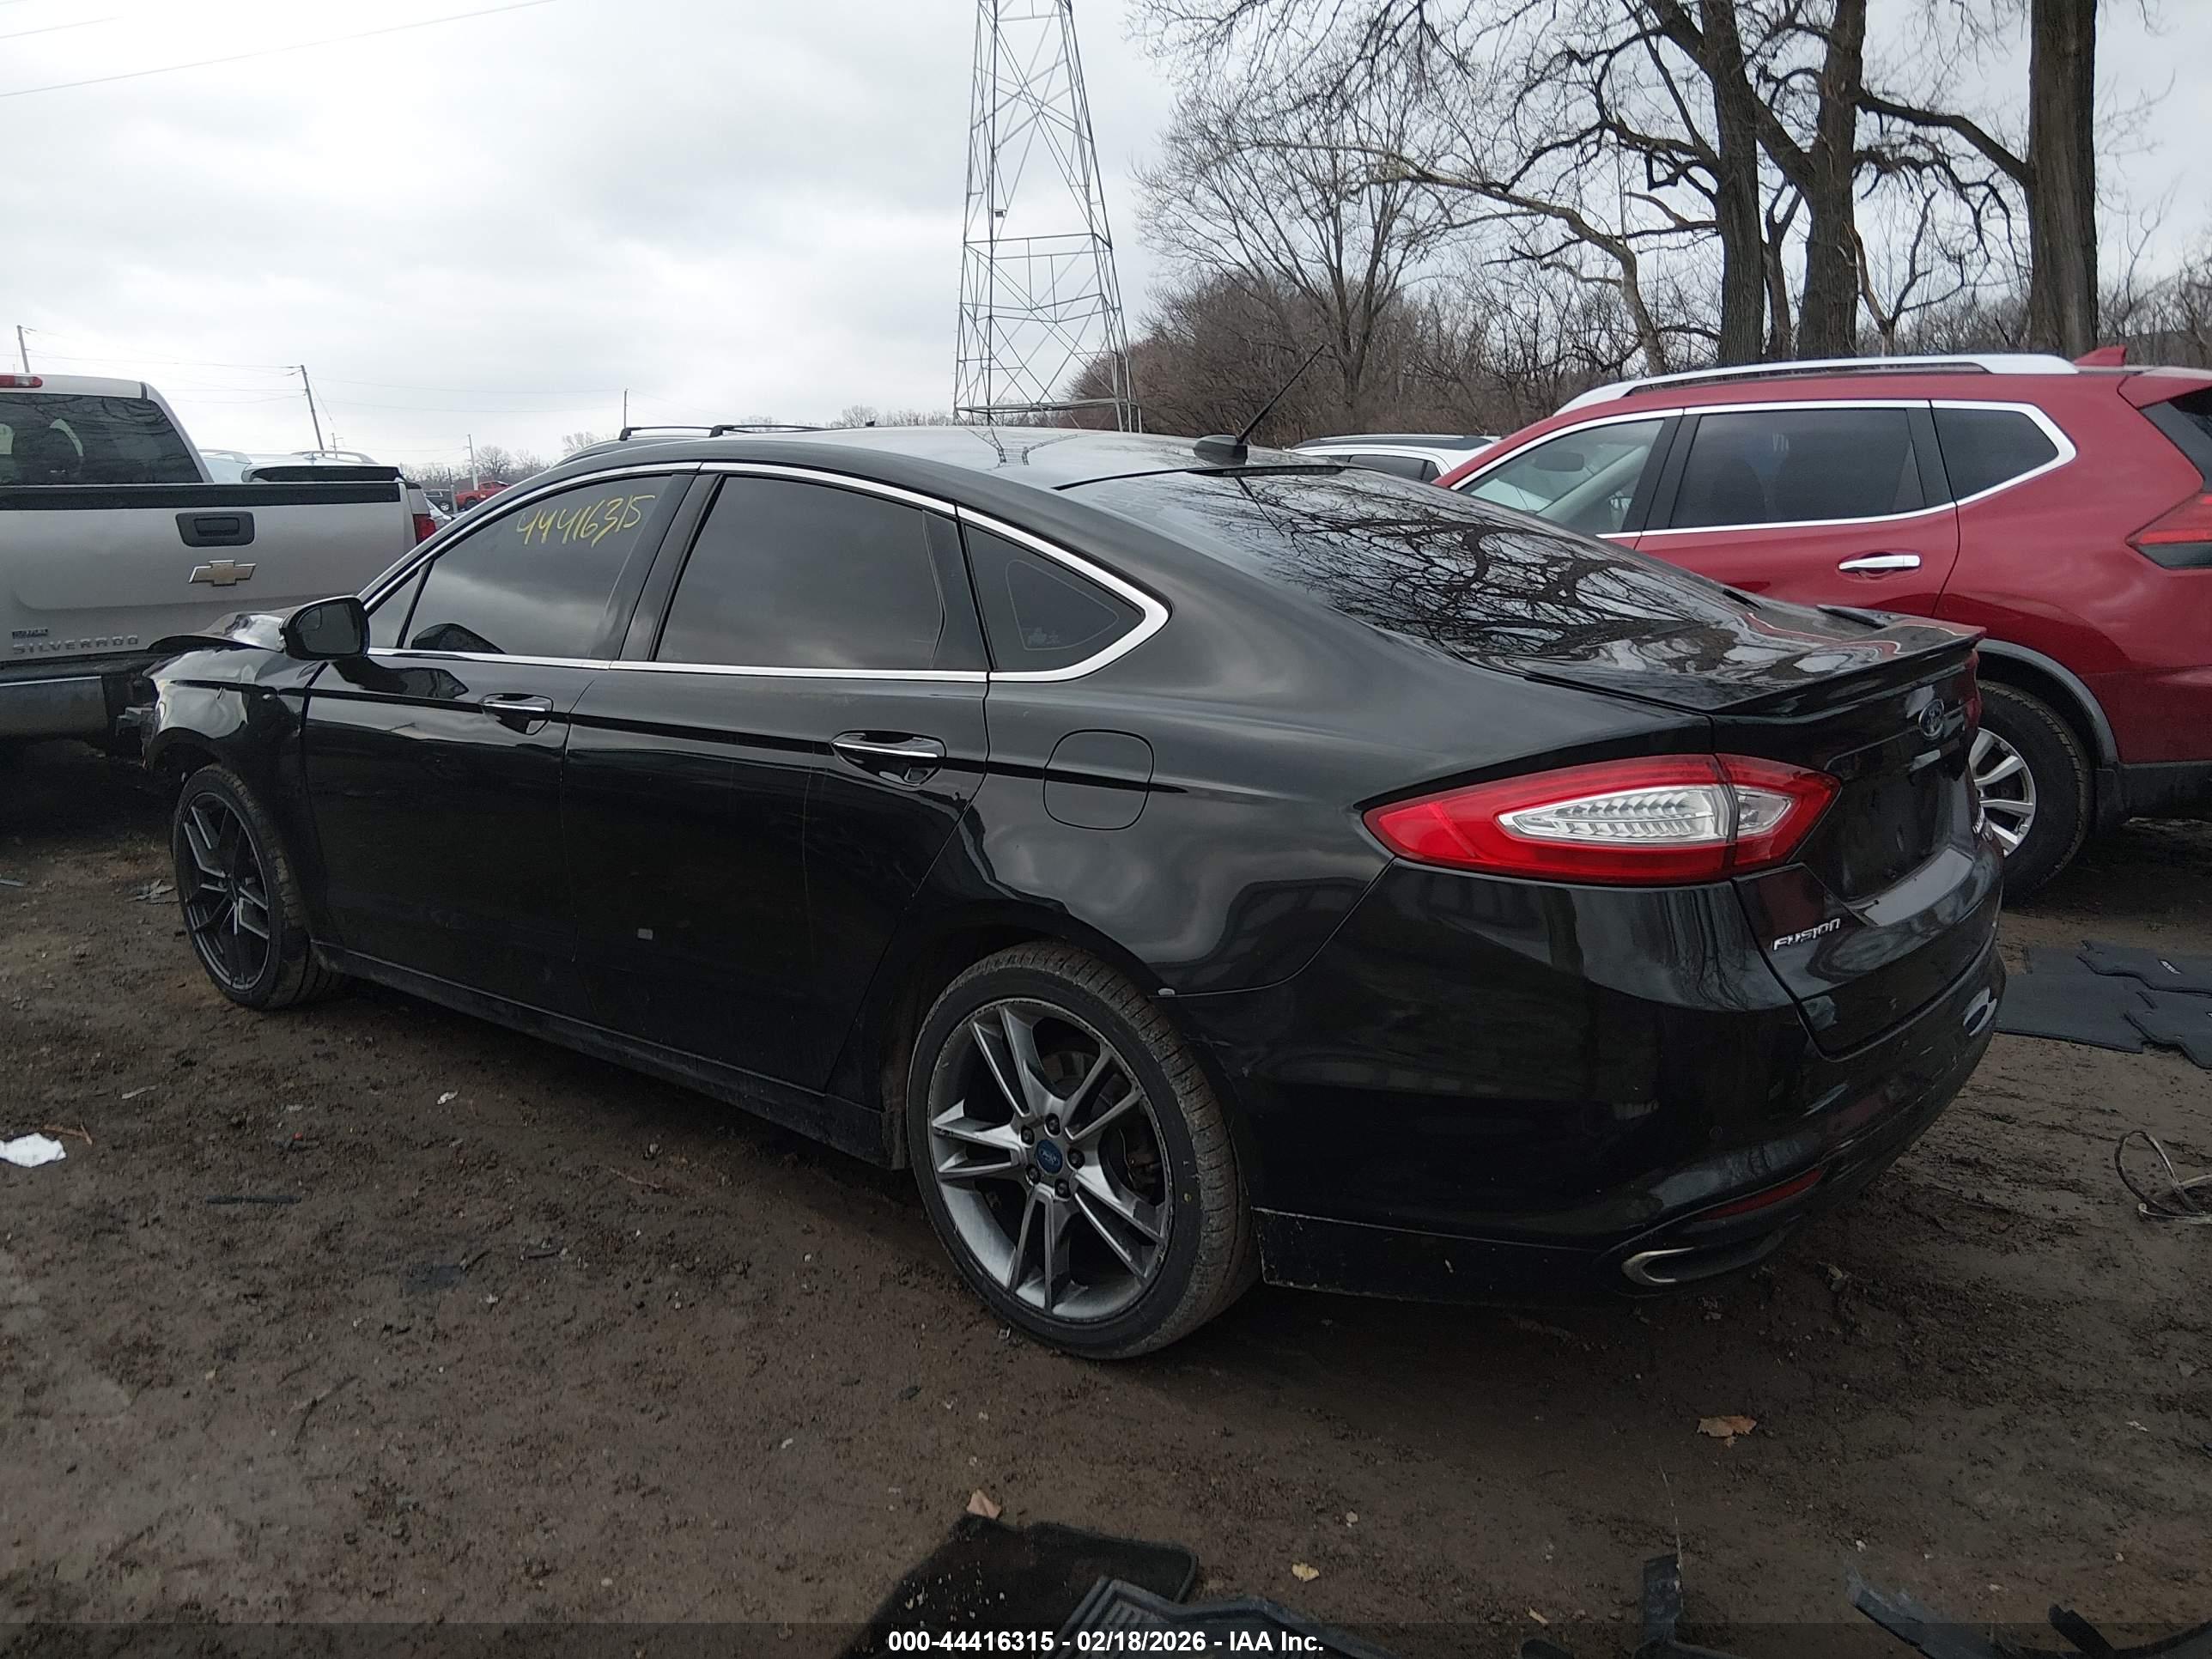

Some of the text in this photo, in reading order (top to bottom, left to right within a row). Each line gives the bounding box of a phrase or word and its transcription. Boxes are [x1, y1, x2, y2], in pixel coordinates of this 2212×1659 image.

[515, 494, 655, 548] 44416315
[12, 635, 139, 654] SILVERADO
[1772, 917, 1841, 951] FUSION
